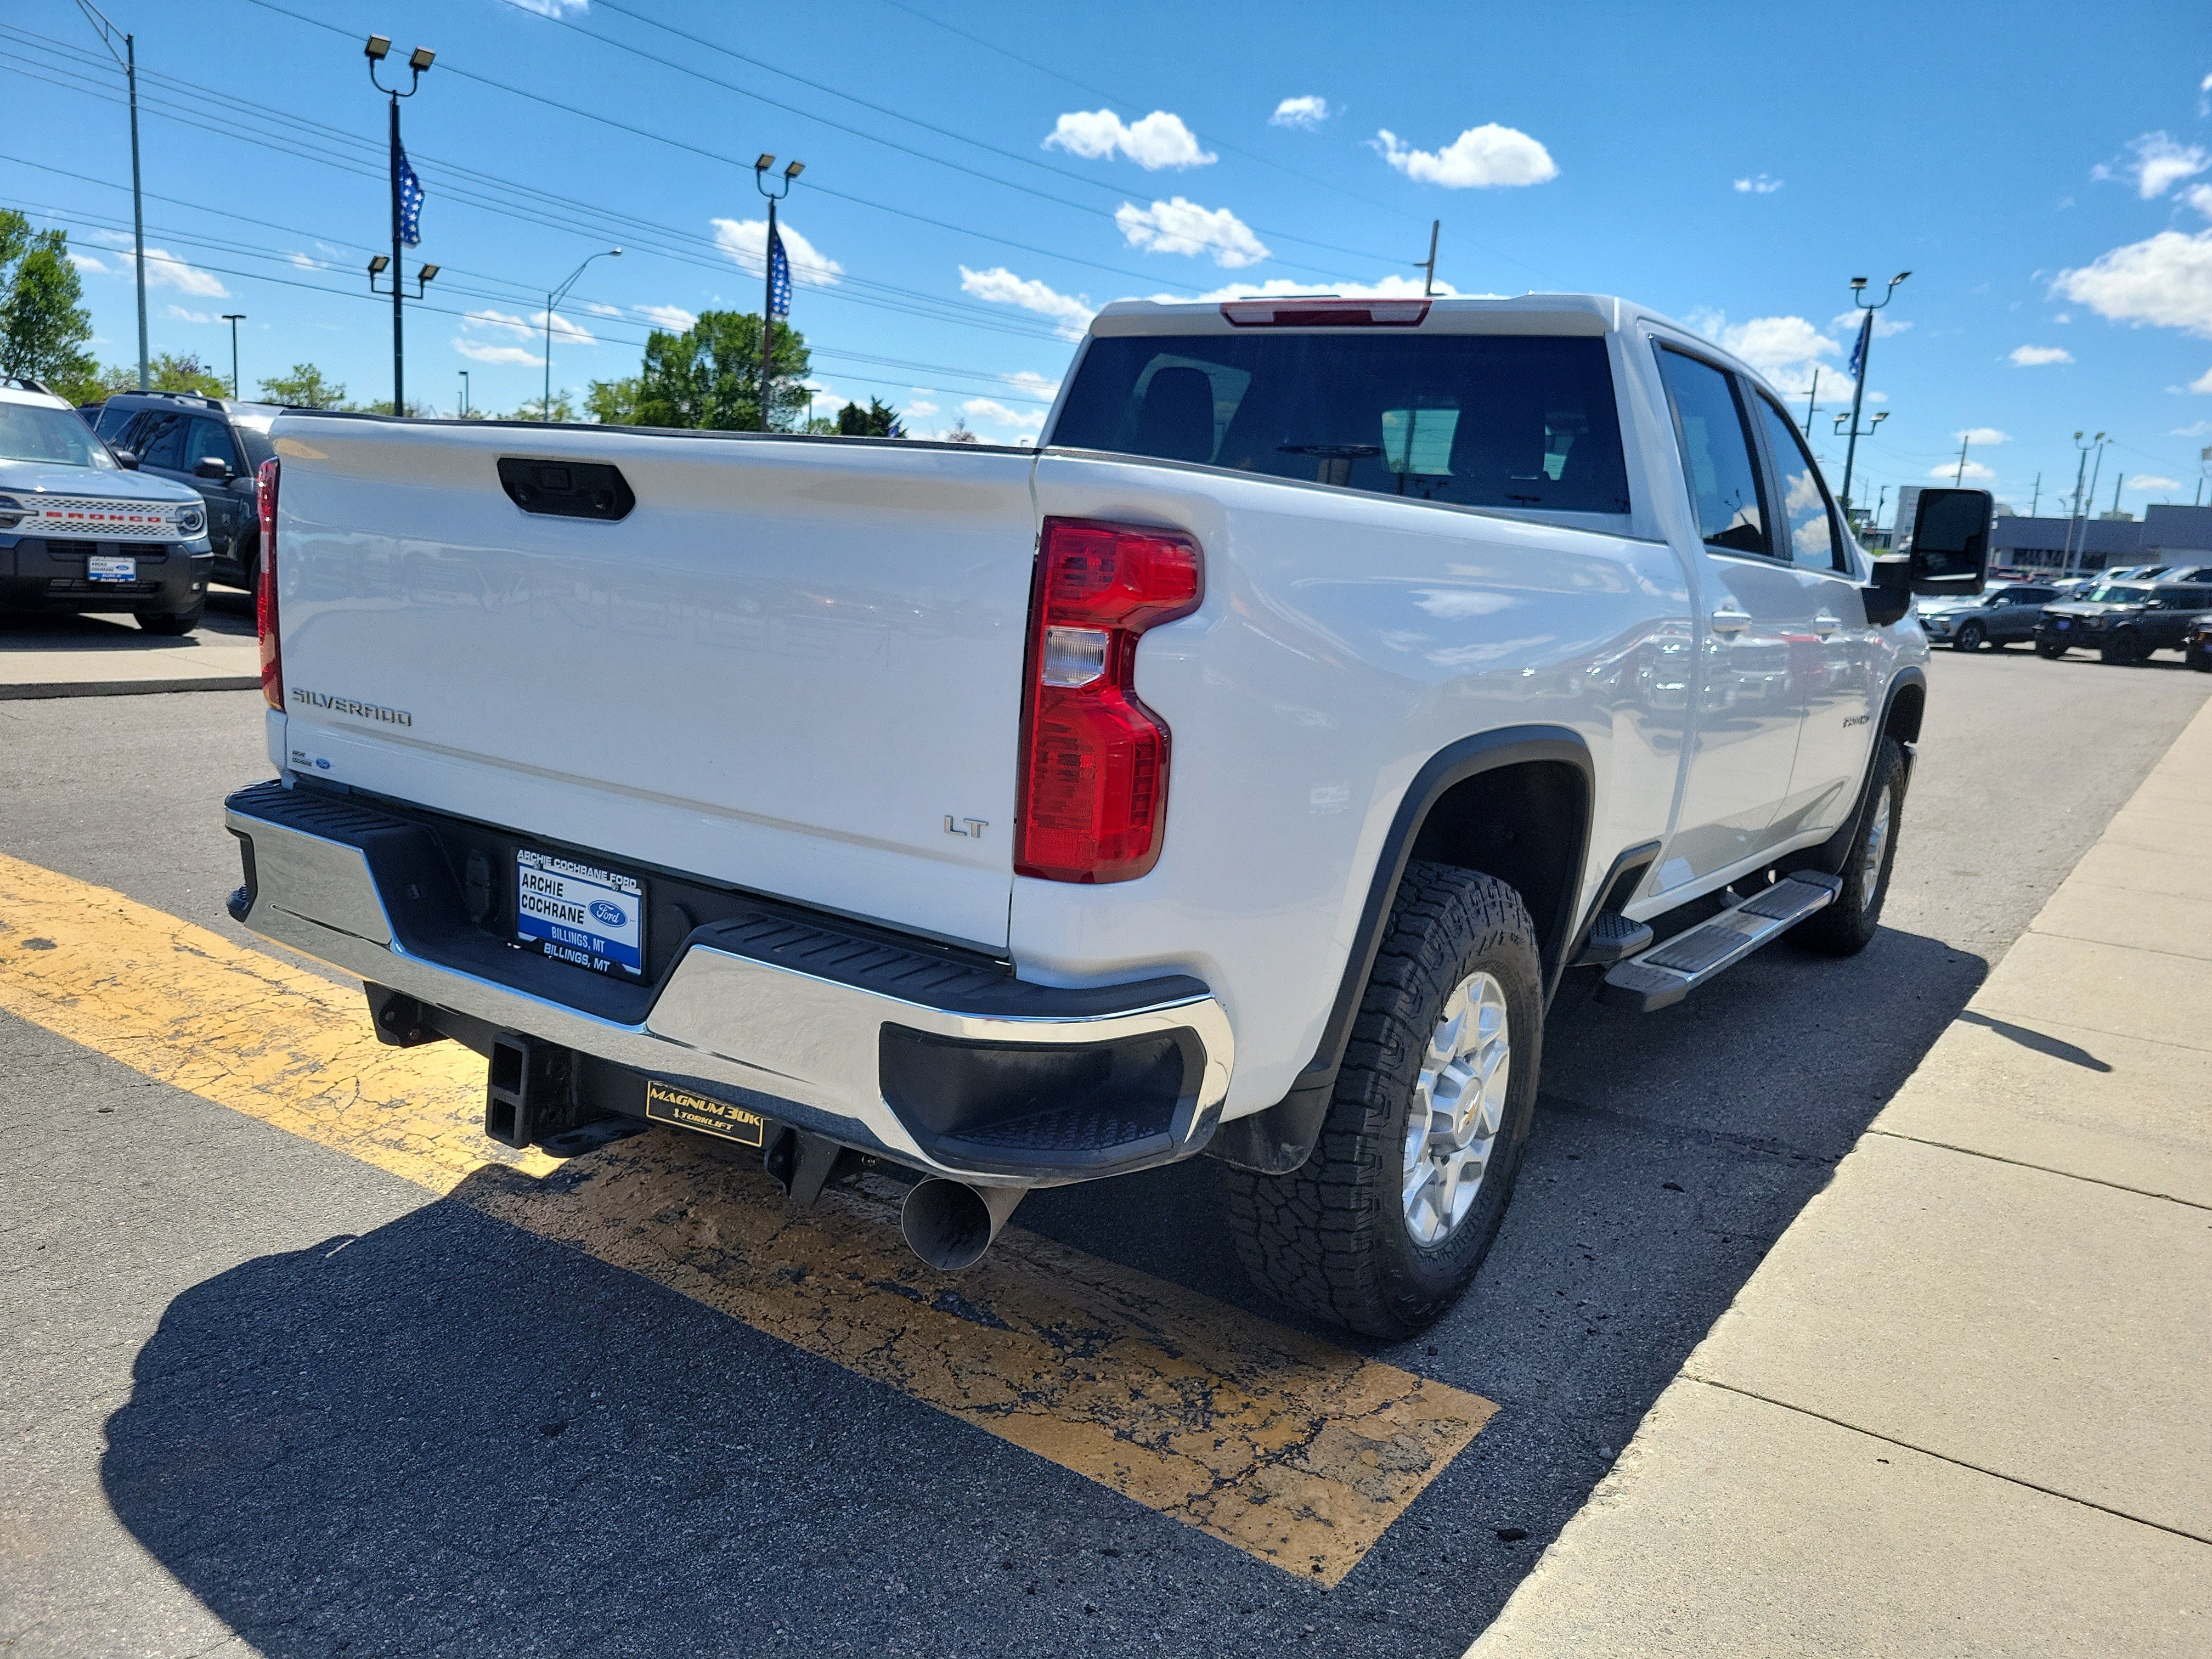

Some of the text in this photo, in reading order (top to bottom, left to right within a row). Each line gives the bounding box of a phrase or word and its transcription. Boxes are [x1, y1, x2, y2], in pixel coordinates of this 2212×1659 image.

[46, 511, 161, 523] BRONCO
[291, 687, 412, 727] SILVERADO
[944, 815, 989, 838] LT
[517, 849, 637, 889] ARCHIE COCHRANE FORD
[522, 873, 564, 898] ARCHIE
[521, 894, 585, 924] COCHRANE
[551, 926, 605, 953] BILLINGS, MT
[544, 943, 611, 972] BILLINGS, MT
[650, 1088, 761, 1126] MAGNUM 30K
[680, 1111, 735, 1131] TORKLIFT
